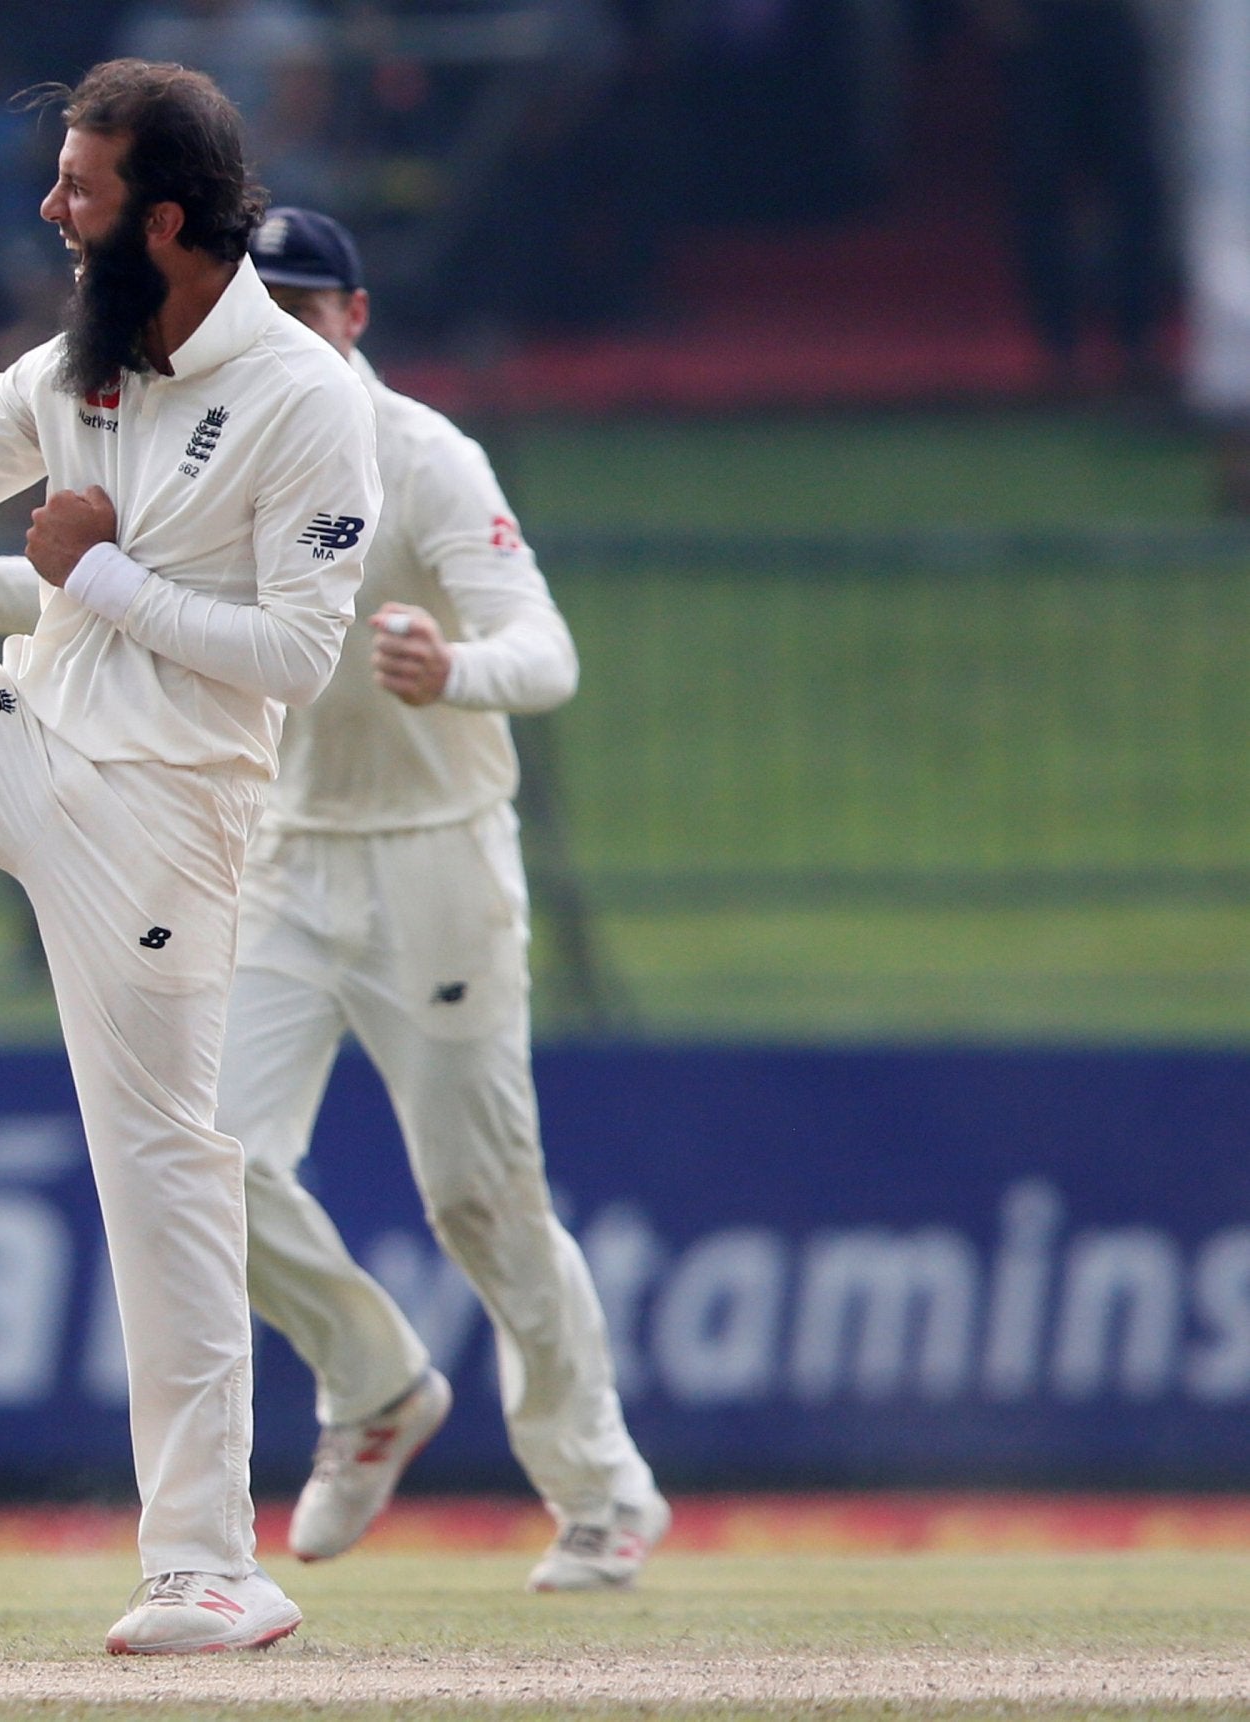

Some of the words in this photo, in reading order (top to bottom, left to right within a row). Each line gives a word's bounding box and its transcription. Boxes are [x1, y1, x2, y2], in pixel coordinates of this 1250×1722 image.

[78, 408, 118, 433] NatWst
[312, 547, 335, 561] MA
[363, 1178, 1250, 1405] vtamins
